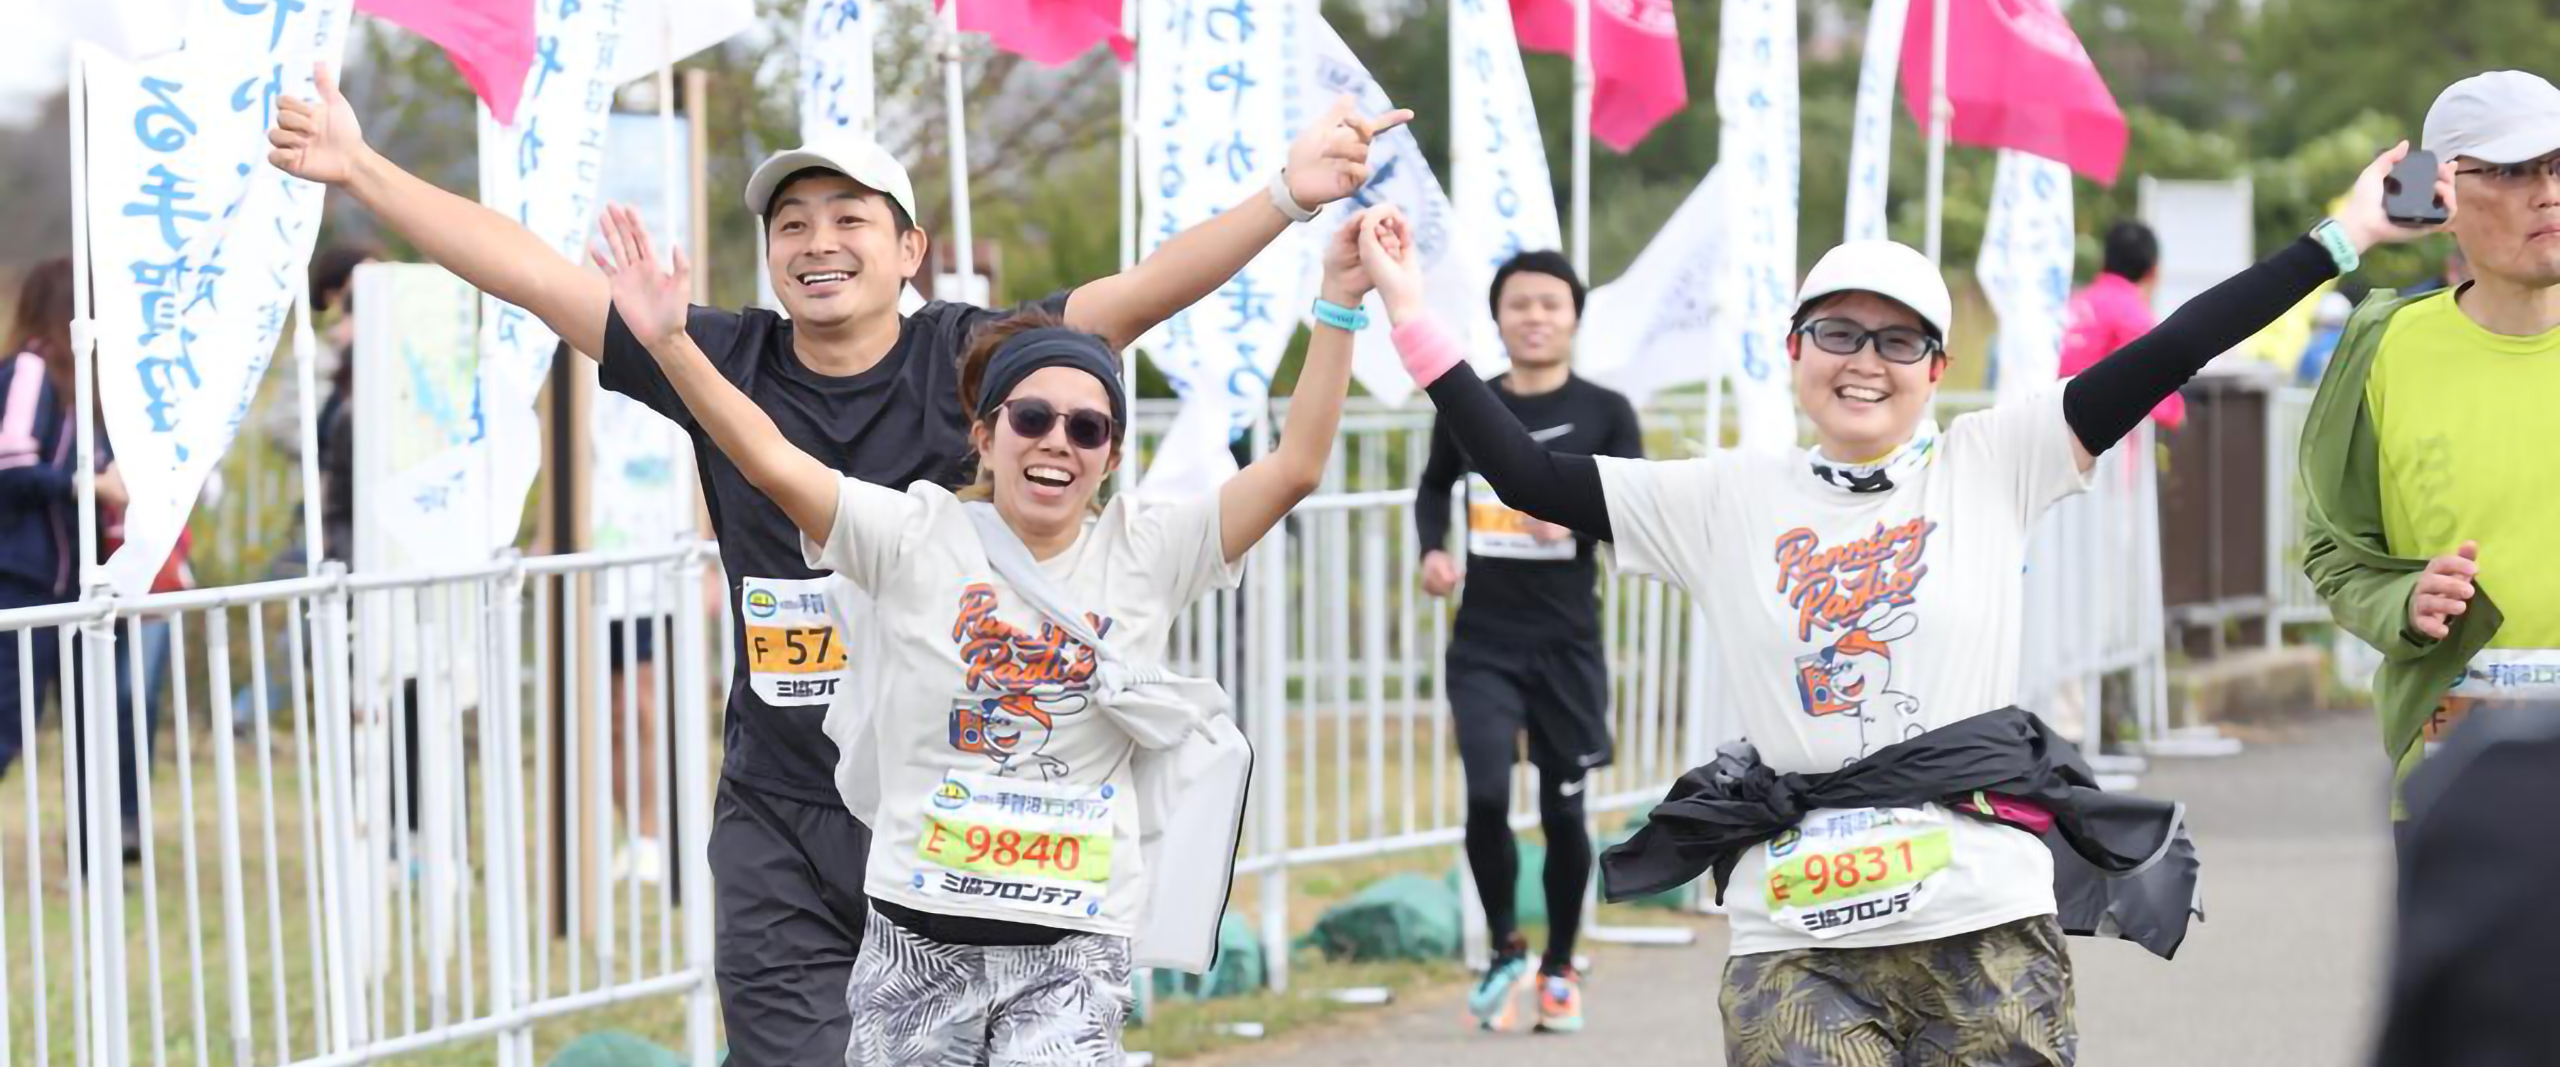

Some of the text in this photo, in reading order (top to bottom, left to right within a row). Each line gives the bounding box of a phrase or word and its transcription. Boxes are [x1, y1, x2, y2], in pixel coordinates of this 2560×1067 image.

[1775, 515, 1938, 594] Running
[1789, 563, 1928, 642] Radio
[754, 637, 769, 664] F
[960, 637, 1098, 692] Radio
[2431, 705, 2447, 735] F
[926, 822, 1080, 872] E 9840
[1770, 840, 1913, 900] E 9831
[940, 872, 1083, 907] 三協フロンテア
